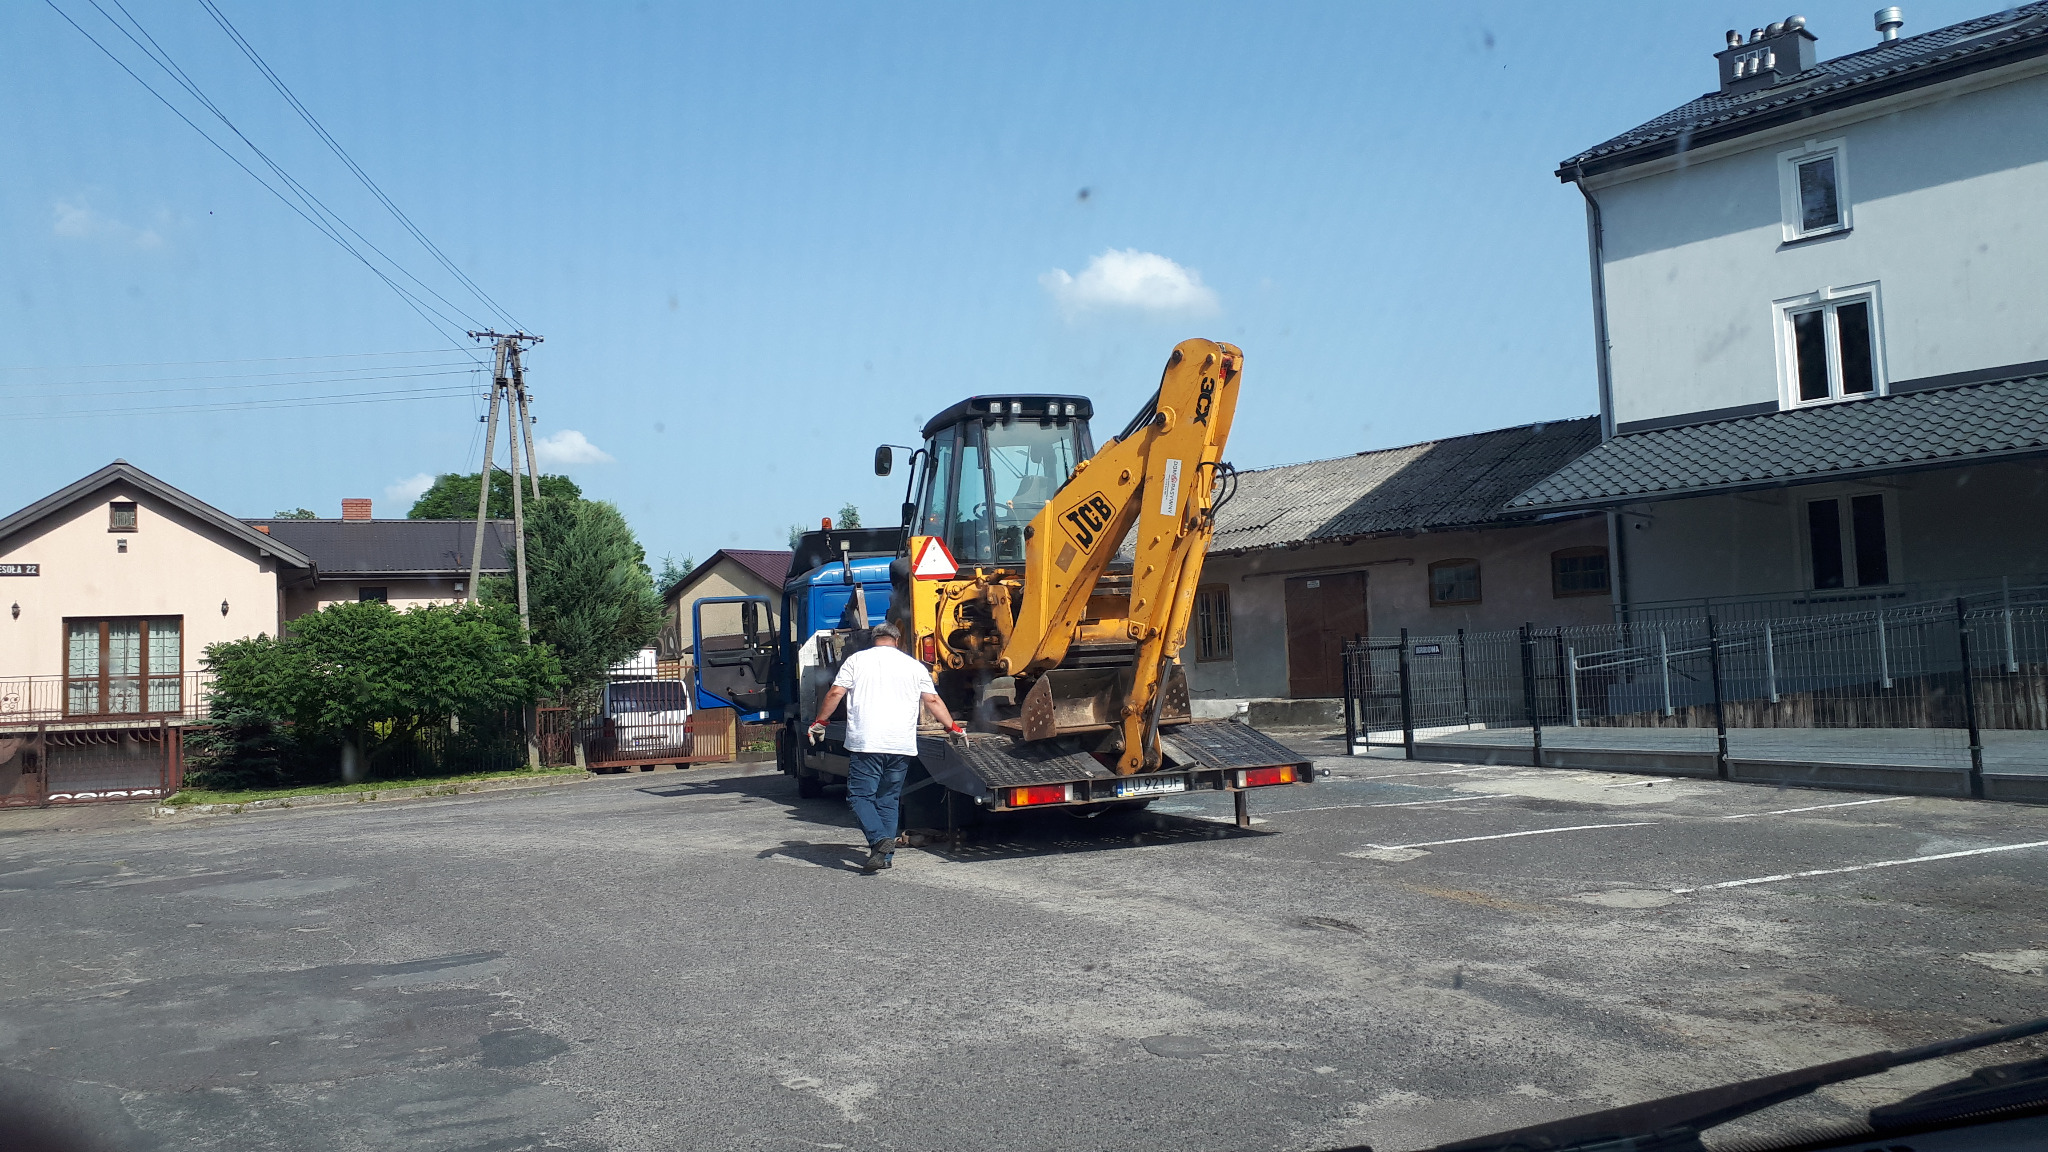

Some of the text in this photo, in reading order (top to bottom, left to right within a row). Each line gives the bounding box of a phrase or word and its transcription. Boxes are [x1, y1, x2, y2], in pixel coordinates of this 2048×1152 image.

[1193, 376, 1215, 427] 3CX
[1066, 496, 1112, 549] JCB
[26, 565, 37, 574] 22
[1125, 778, 1141, 793] LU
